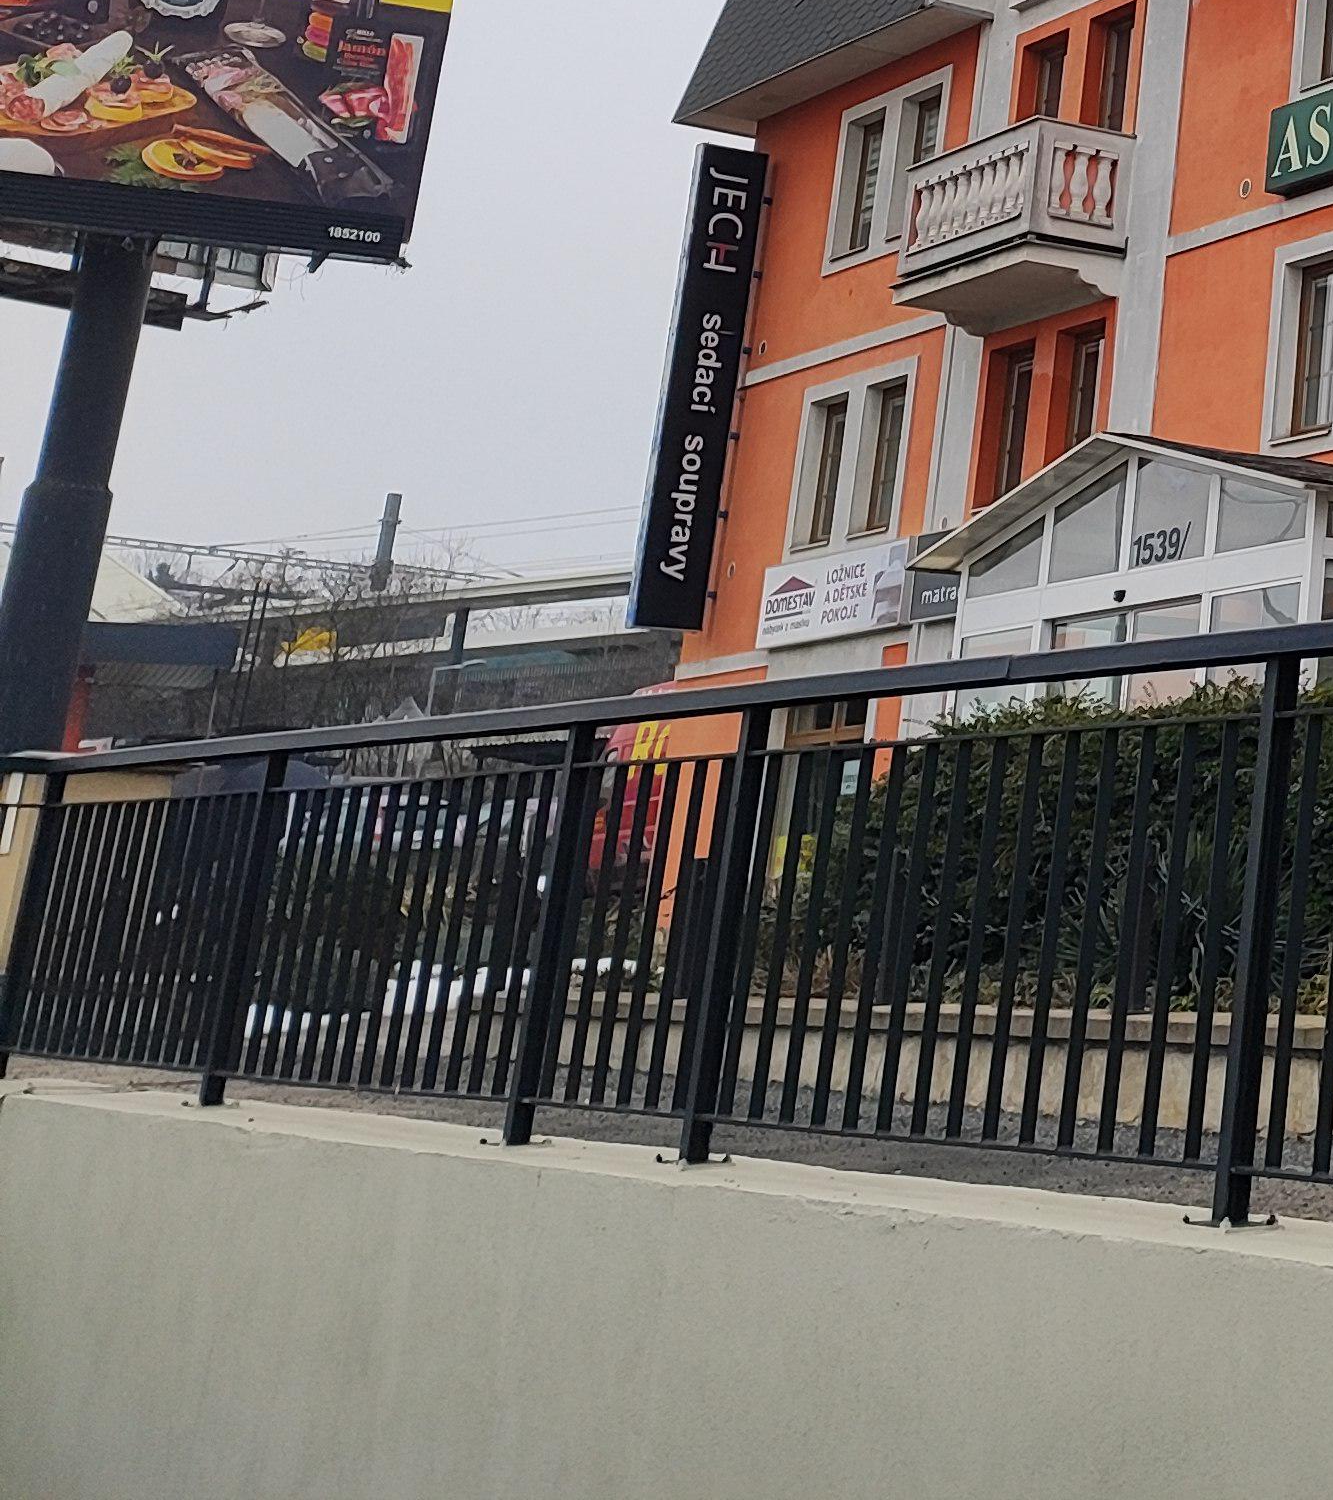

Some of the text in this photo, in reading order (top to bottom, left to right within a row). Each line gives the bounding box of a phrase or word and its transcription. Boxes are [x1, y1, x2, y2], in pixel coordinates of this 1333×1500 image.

[660, 167, 749, 582] JECH sedací soupravy
[826, 563, 866, 585] LOŽNICE
[765, 591, 816, 615] DOMESTAV
[824, 579, 868, 604] A DĚTSKÉ
[820, 604, 859, 625] POKOJE
